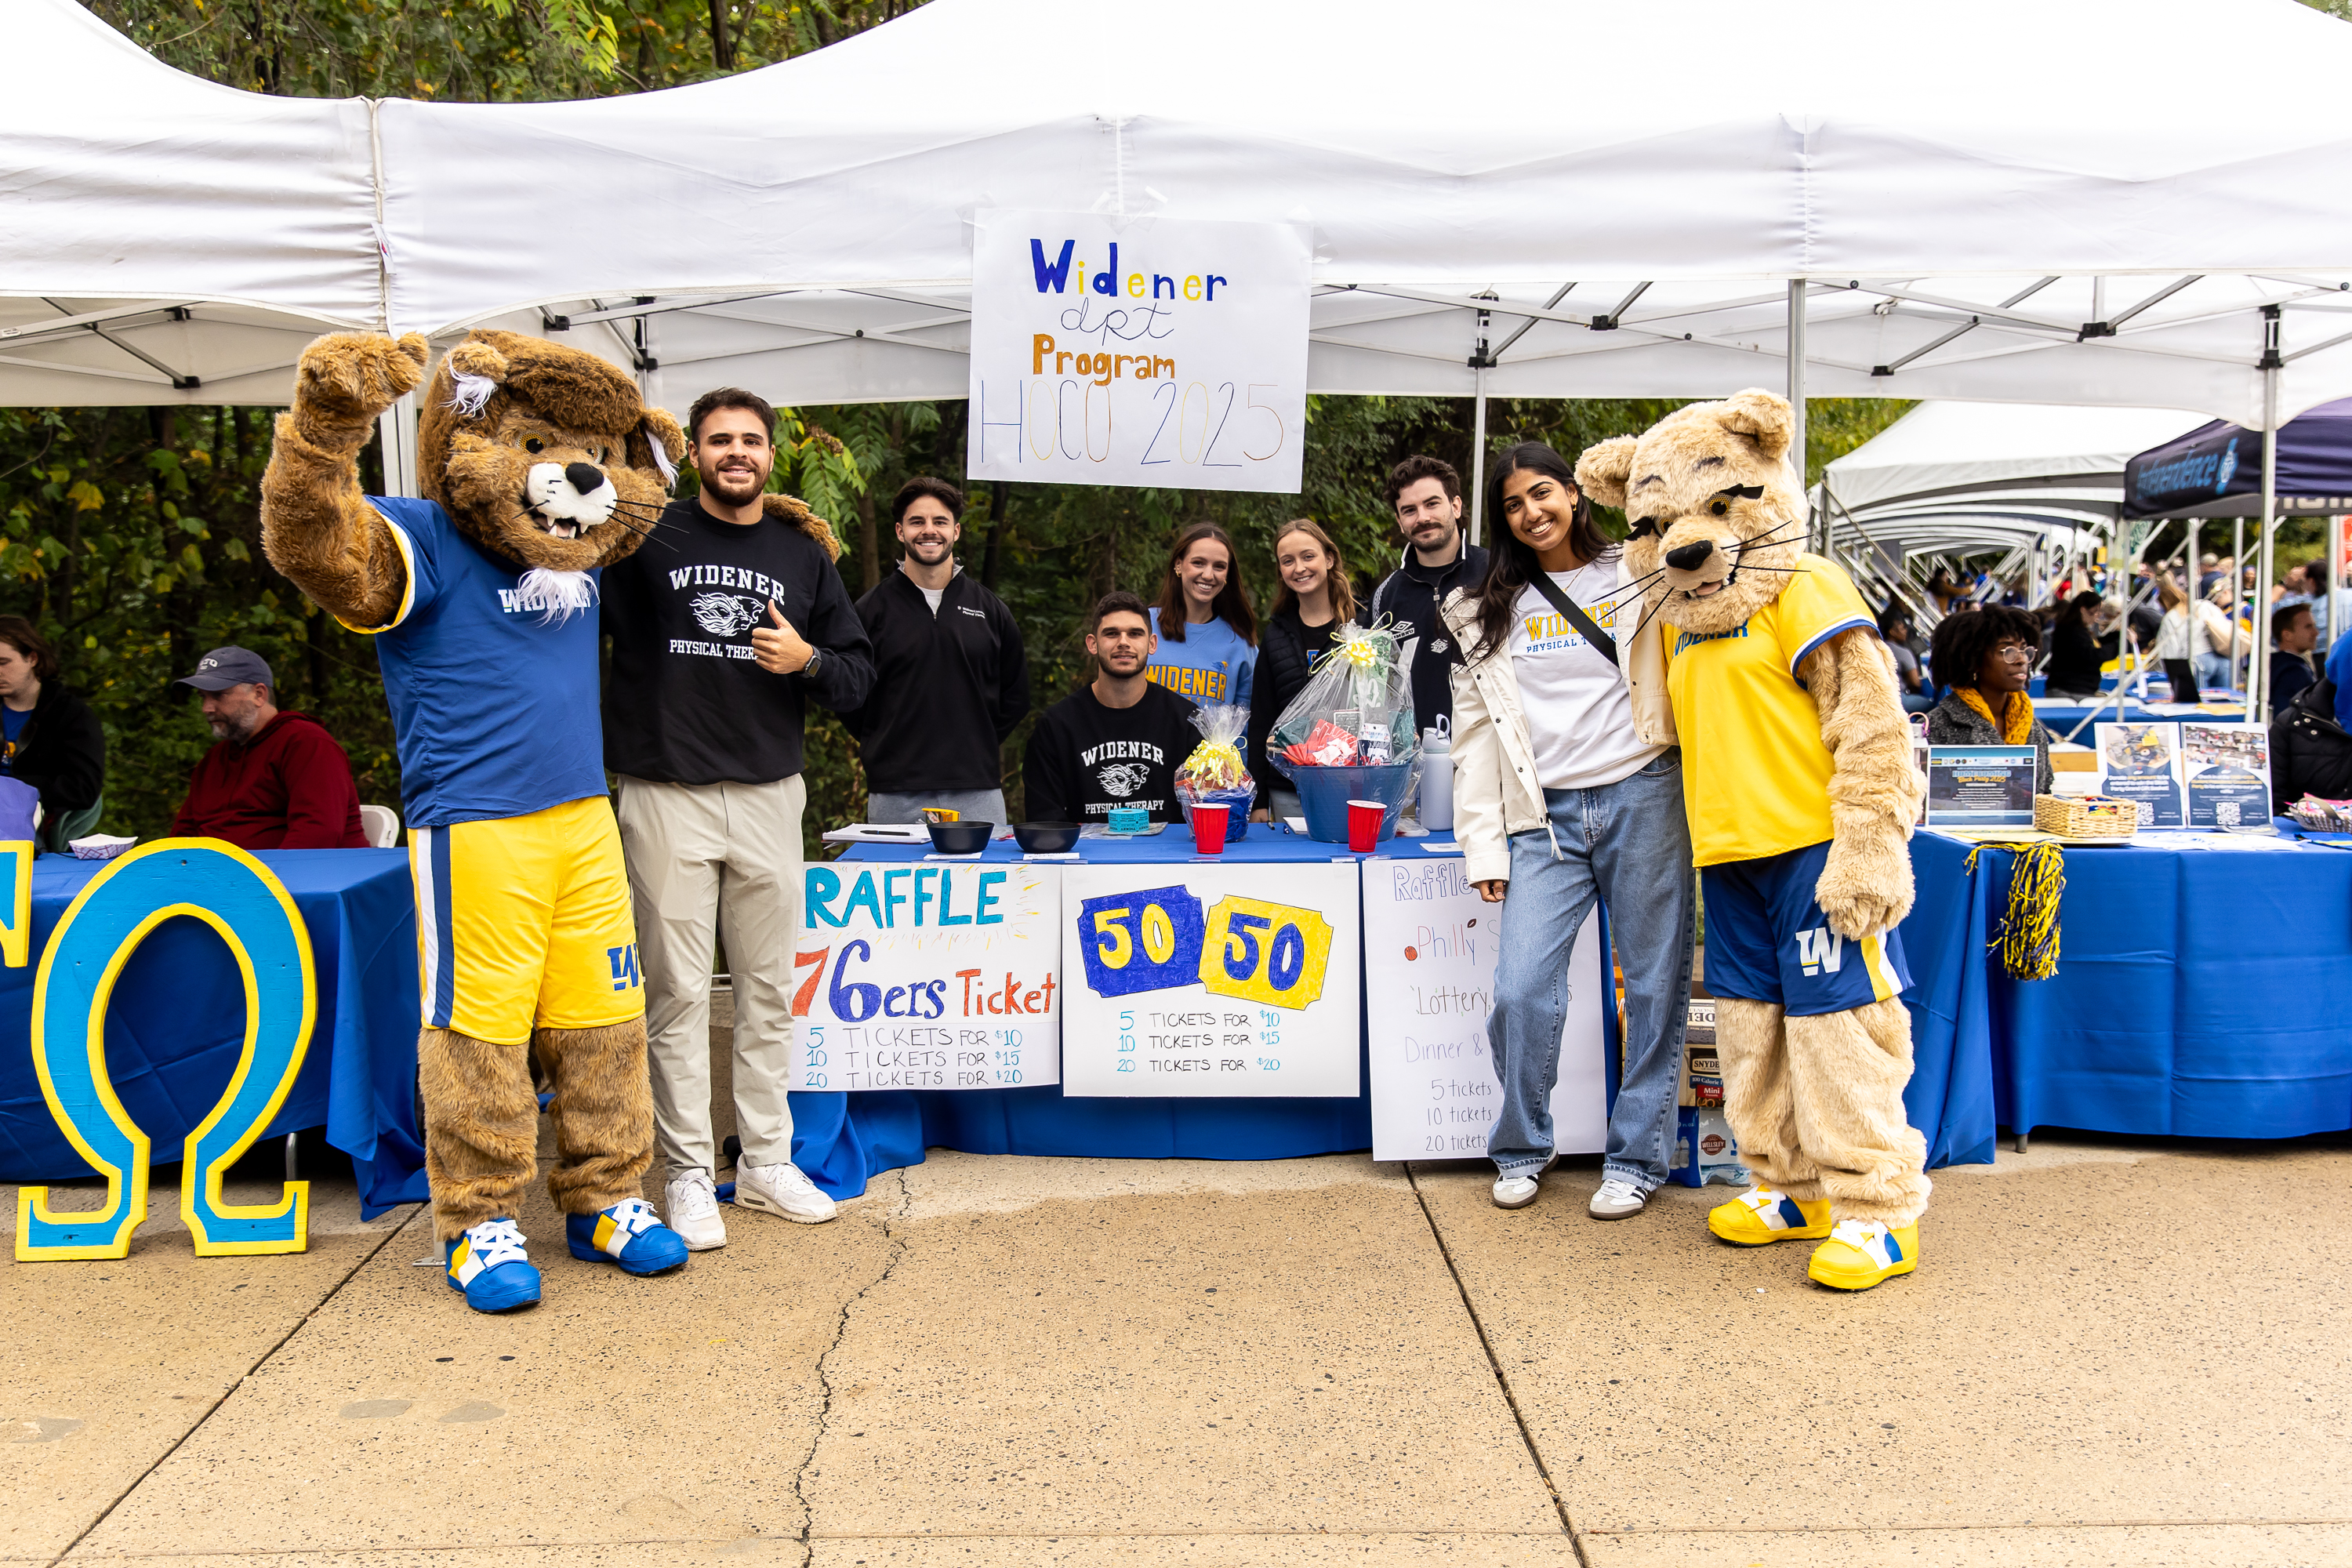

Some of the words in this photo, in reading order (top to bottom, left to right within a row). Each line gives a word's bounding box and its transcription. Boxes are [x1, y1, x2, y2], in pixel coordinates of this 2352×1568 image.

[1030, 238, 1227, 301] Widener
[1033, 334, 1175, 386] Program
[982, 379, 1111, 463] HOCO
[1141, 382, 1283, 467] 2025
[669, 564, 785, 605] WIDENER
[670, 639, 723, 657] PHYSICAL
[726, 644, 759, 660] THER
[1527, 638, 1577, 653] PHYSICAL
[1145, 664, 1228, 702] WIDENER
[1081, 741, 1163, 767] WIDENER
[1085, 803, 1122, 814] PHYSICAL
[1125, 800, 1164, 811] THERAPY
[1393, 862, 1473, 902] Raffle
[805, 867, 1007, 929] RAFFLE
[1094, 903, 1175, 970] 50
[1417, 924, 1475, 966] Philly
[1223, 912, 1305, 991] 50
[791, 939, 946, 1023] 76ers
[956, 968, 1056, 1017] Ticket
[1417, 985, 1488, 1018] Lottery
[1120, 1011, 1135, 1031] 5
[1149, 1012, 1216, 1028] TICKETS
[1225, 1013, 1252, 1028] FOR
[1259, 1009, 1279, 1028] $10
[806, 1027, 825, 1048] 5
[843, 1027, 953, 1048] TICKETS
[960, 1030, 989, 1046] FOR
[994, 1029, 1022, 1047] $10
[1117, 1034, 1135, 1052] 10
[1149, 1033, 1214, 1049] TICKETS
[1223, 1034, 1251, 1046] FOR
[1259, 1031, 1279, 1045] $15
[1405, 1036, 1464, 1062] Dinner
[1473, 1033, 1483, 1056] &
[806, 1050, 827, 1067] 10
[845, 1051, 946, 1068] TICKETS
[958, 1052, 989, 1067] FOR
[995, 1050, 1021, 1065] $15
[1116, 1058, 1136, 1073] 20
[1149, 1058, 1210, 1073] TICKETS
[1221, 1059, 1247, 1072] FOR
[1256, 1057, 1279, 1071] $20
[806, 1071, 828, 1088] 20
[846, 1071, 943, 1088] TICKETS
[958, 1071, 989, 1086] FOR
[996, 1069, 1022, 1083] $20
[1431, 1079, 1445, 1100] 5
[1448, 1079, 1492, 1098] tickets
[1427, 1107, 1443, 1126] 10
[1449, 1106, 1492, 1124] tickets
[1425, 1134, 1445, 1152] 20
[1450, 1133, 1488, 1151] tickets
